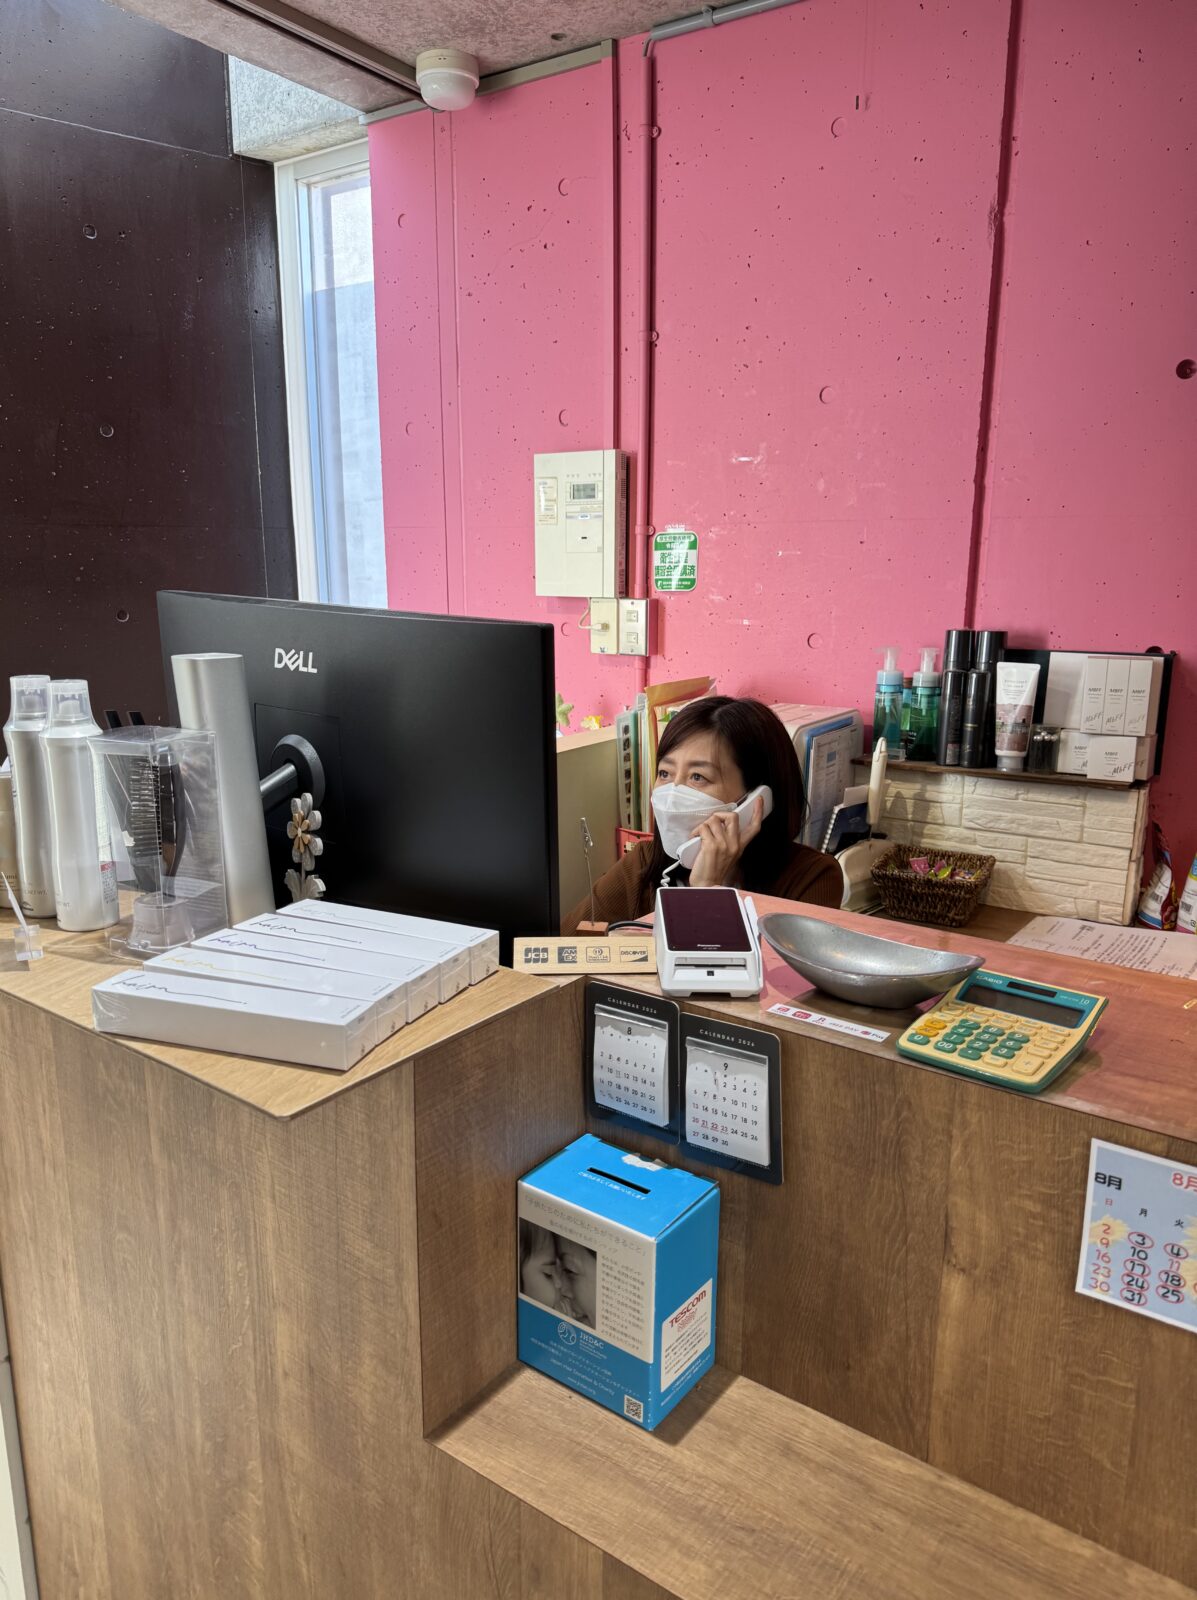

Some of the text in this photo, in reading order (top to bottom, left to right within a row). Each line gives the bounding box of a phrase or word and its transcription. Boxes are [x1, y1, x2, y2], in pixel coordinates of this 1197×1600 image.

[274, 647, 318, 673] DELL
[627, 1027, 632, 1035] 8
[699, 1029, 734, 1042] CALENDAR
[723, 1062, 728, 1071] 9
[1094, 1172, 1123, 1190] 8月
[1139, 1208, 1148, 1217] 月
[1174, 1218, 1184, 1228] 火
[1100, 1237, 1110, 1249] 9
[1130, 1246, 1148, 1261] 10
[1102, 1223, 1181, 1257] 2 3 4
[1095, 1249, 1182, 1287] 16 17 18
[1088, 1277, 1143, 1304] 30 31
[1091, 1263, 1181, 1303] 23 24 25
